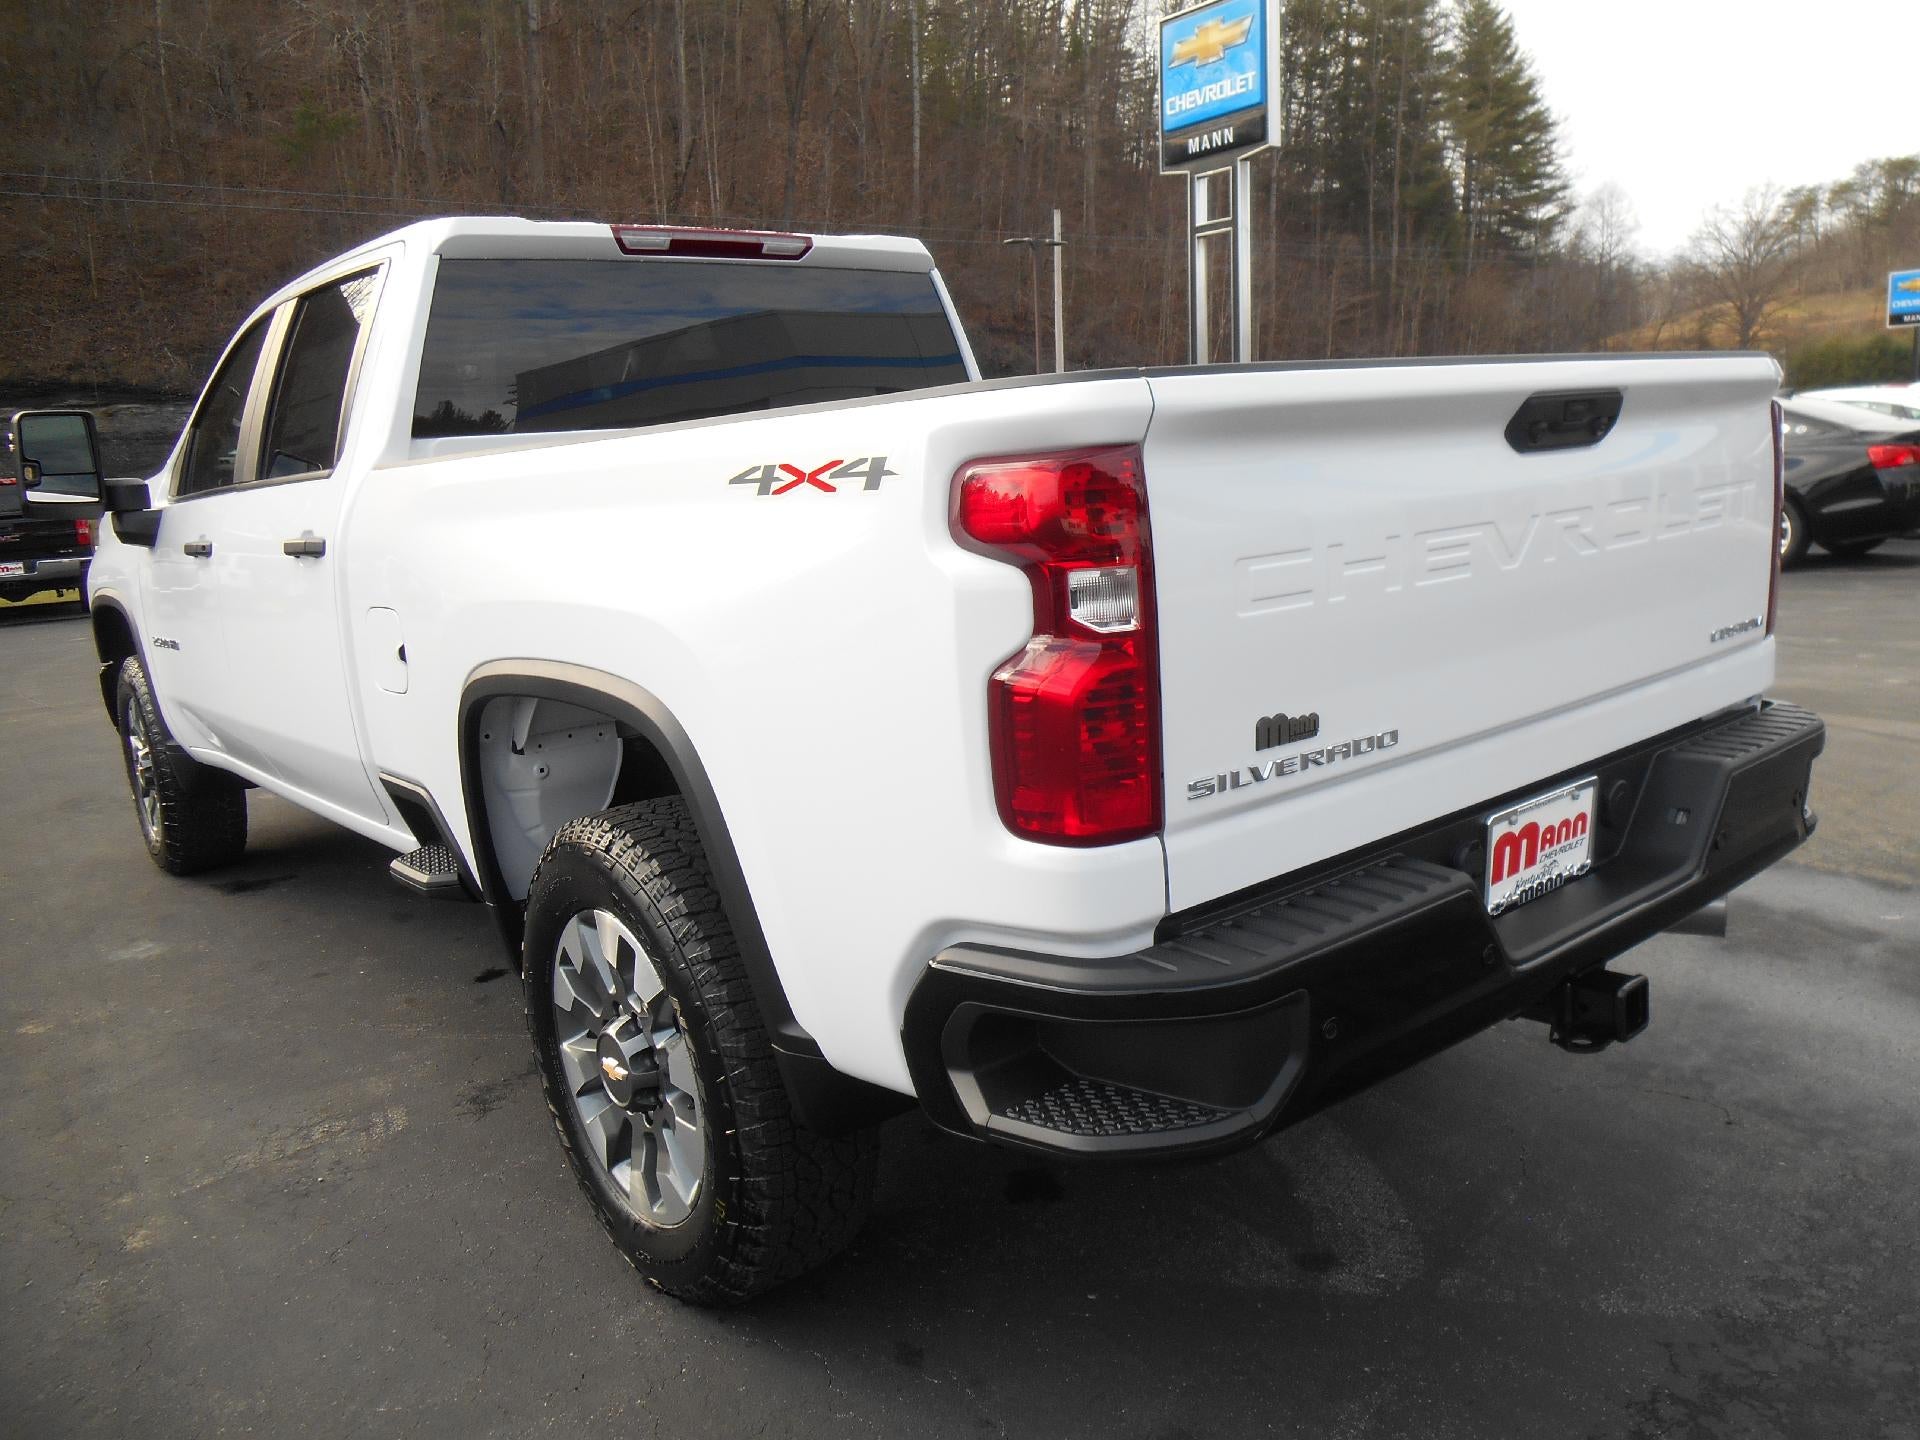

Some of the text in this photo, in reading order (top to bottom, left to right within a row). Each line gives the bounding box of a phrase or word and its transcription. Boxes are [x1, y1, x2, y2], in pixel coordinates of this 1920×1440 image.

[1165, 71, 1256, 116] CHEVROLET
[1187, 126, 1234, 155] MANN
[1903, 314, 1920, 323] MAN
[728, 456, 900, 497] 4X4
[1234, 479, 1757, 618] CHEVROLET
[1187, 729, 1399, 801] SILVERADO
[1539, 836, 1586, 864] CHEVROLET
